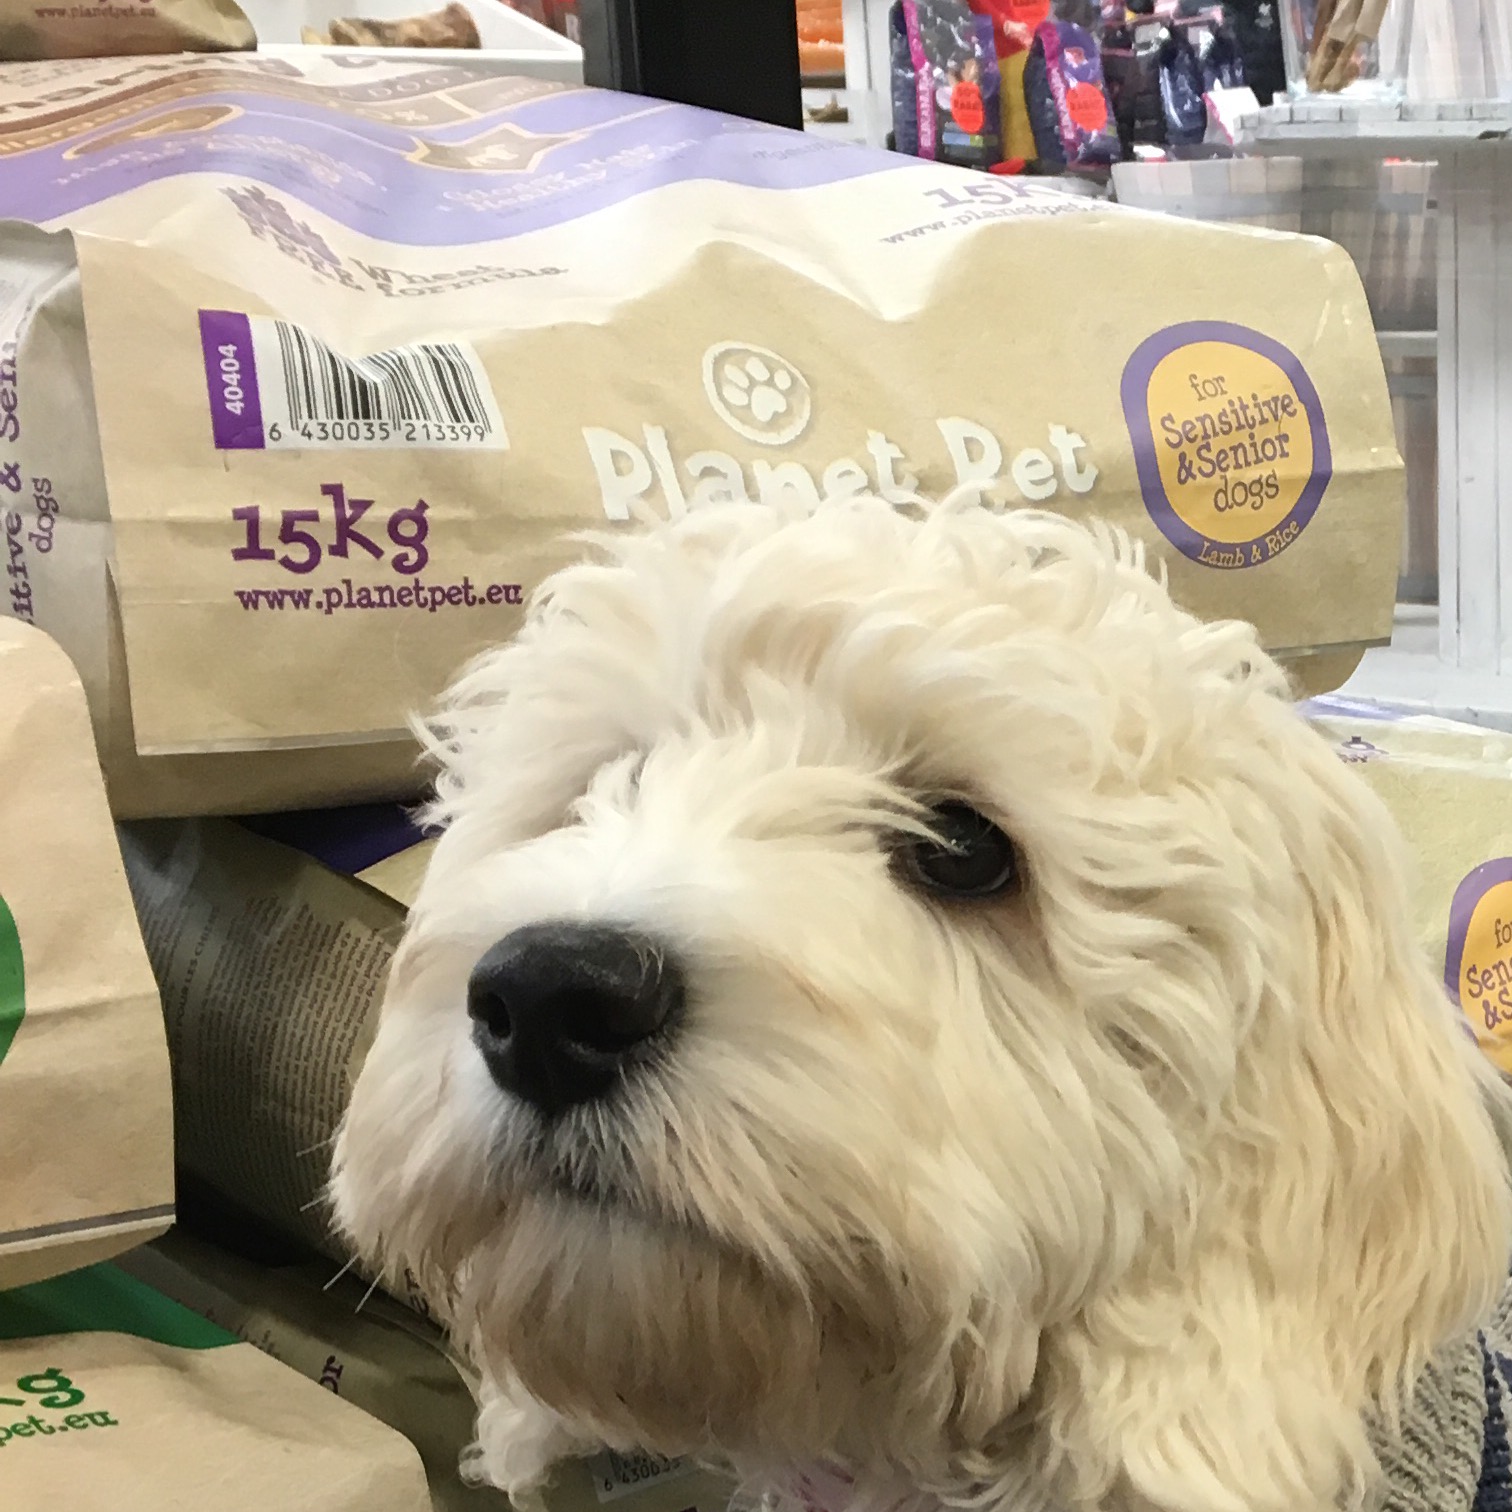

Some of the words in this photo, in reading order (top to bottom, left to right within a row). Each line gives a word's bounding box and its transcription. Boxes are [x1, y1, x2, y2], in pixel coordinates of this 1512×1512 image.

[924, 177, 1060, 209] 15k
[217, 344, 245, 415] 40404
[1189, 373, 1228, 402] for
[269, 422, 282, 442] 6
[300, 422, 391, 441] 430035
[405, 422, 487, 442] 213399
[1160, 392, 1298, 449] Sensitive
[582, 422, 919, 521] Planet
[936, 416, 1098, 507] Pet
[1213, 468, 1280, 513] dogs
[28, 477, 60, 553] dogs
[231, 481, 430, 574] 15kg
[5, 511, 34, 626] itive
[1198, 540, 1245, 567] Lamb
[1251, 545, 1262, 563] &
[1265, 519, 1300, 557] Rice
[234, 576, 523, 615] www.planetpet.eu
